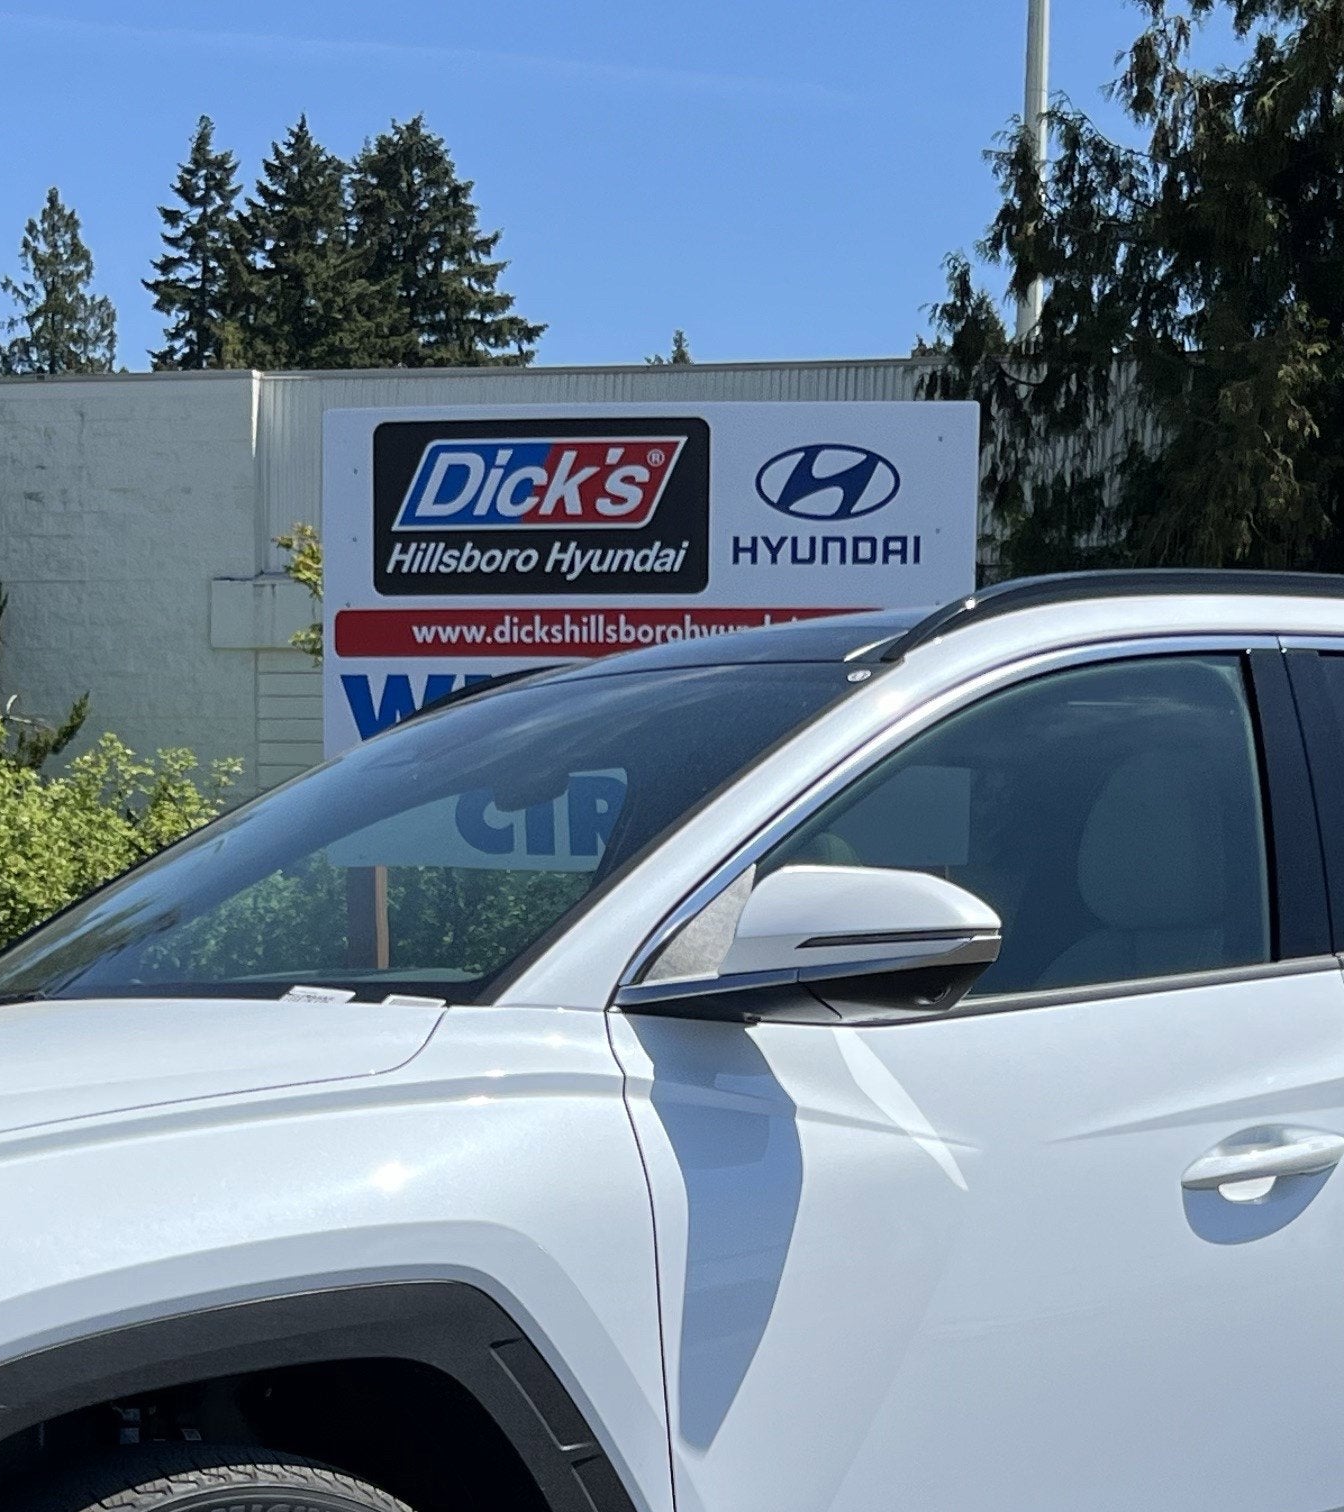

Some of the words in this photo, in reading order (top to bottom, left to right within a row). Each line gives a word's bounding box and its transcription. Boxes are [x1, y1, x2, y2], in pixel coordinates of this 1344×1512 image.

[385, 541, 543, 575] Hillsboro
[544, 540, 690, 582] Hyundai
[732, 535, 922, 566] HYUNDAI
